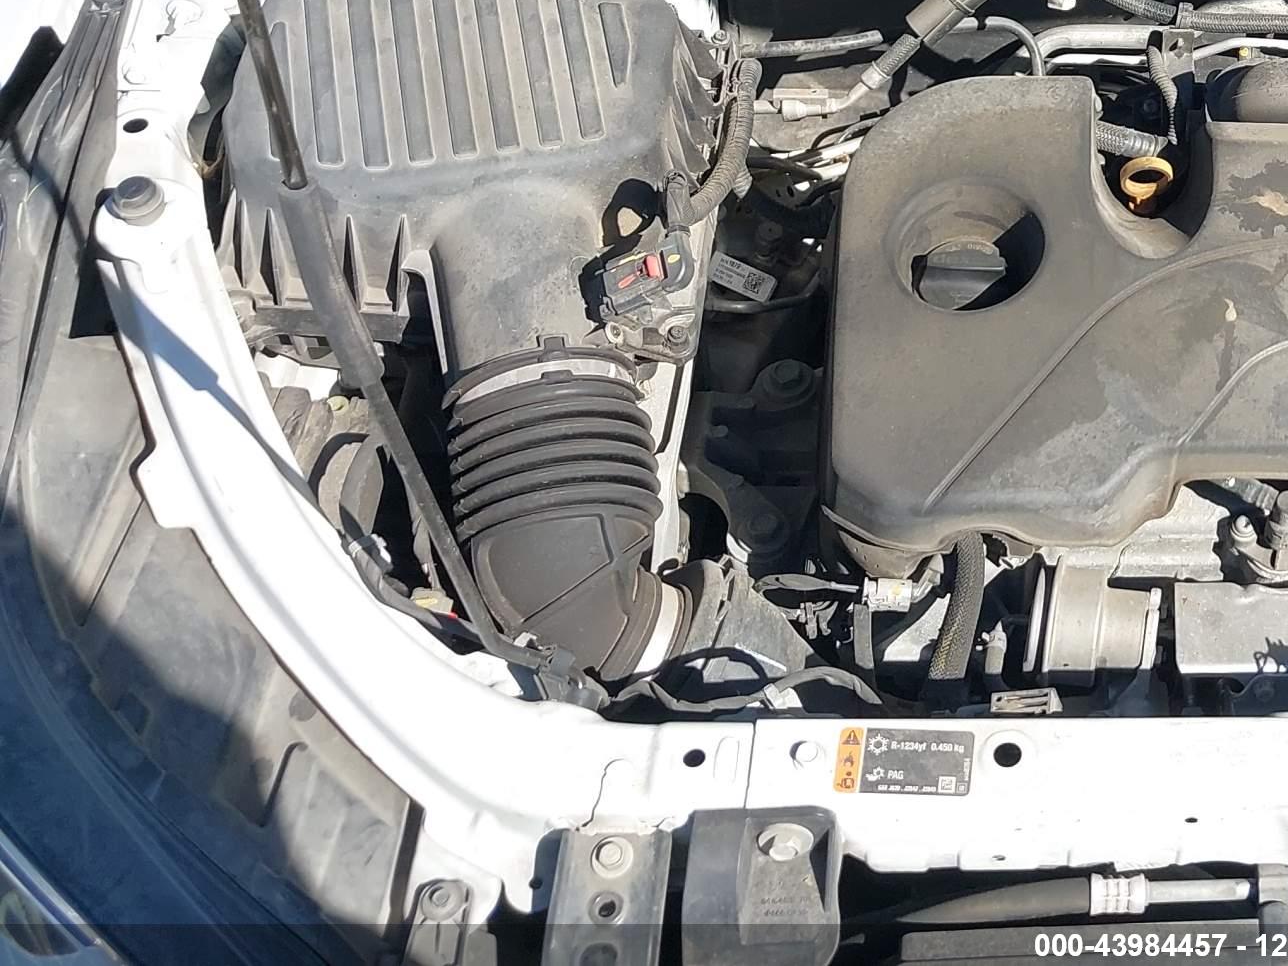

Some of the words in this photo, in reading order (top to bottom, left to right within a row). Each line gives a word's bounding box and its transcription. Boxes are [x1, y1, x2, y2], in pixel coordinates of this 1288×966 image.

[891, 741, 927, 753] R-1234yf
[930, 742, 953, 752] 0.450
[887, 769, 905, 780] PAG
